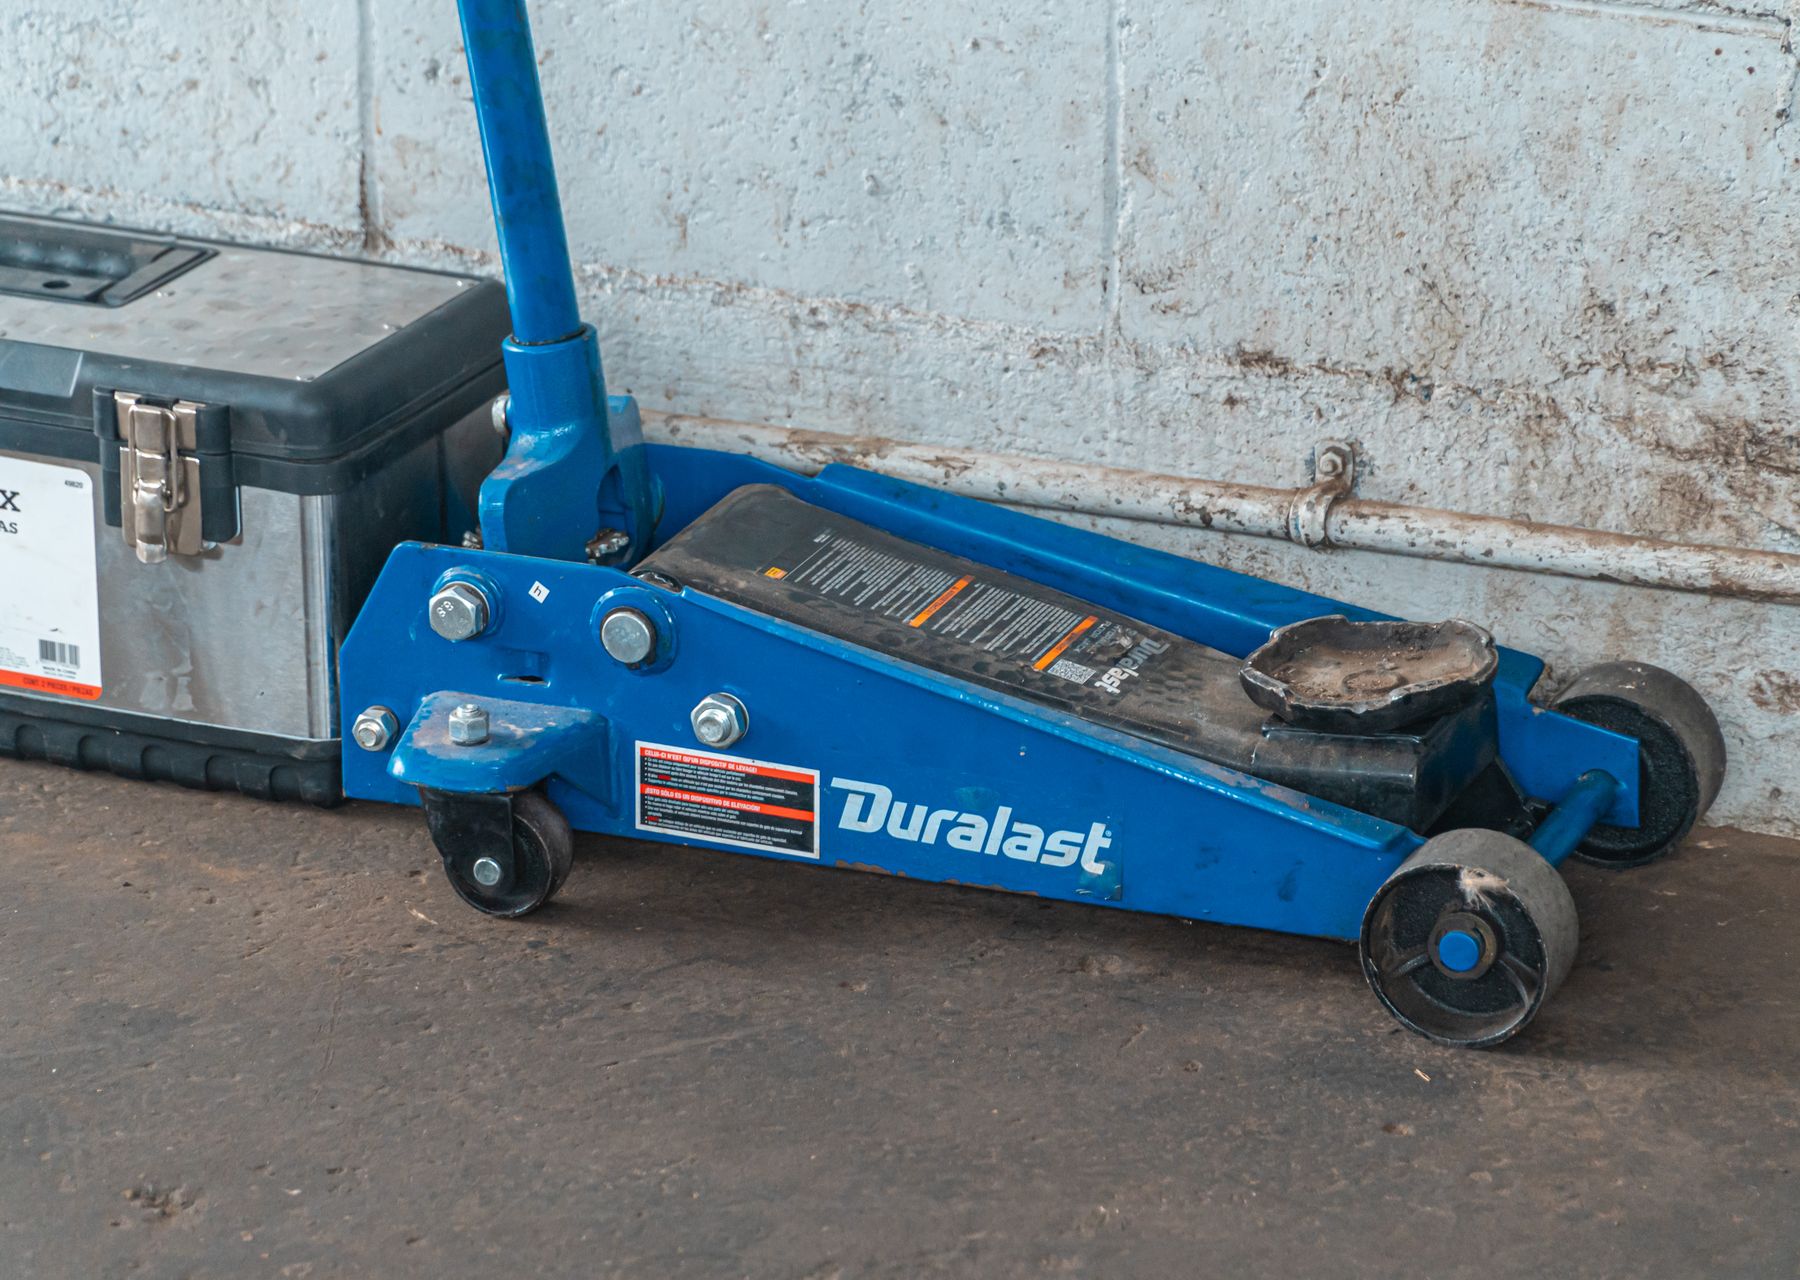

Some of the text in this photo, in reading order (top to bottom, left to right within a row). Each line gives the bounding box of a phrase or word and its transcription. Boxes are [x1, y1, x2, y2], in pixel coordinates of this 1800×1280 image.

[1094, 637, 1171, 694] Duralast
[675, 791, 682, 799] ES
[682, 793, 690, 801] UN
[723, 799, 730, 807] DE
[830, 776, 1112, 875] Duralast
